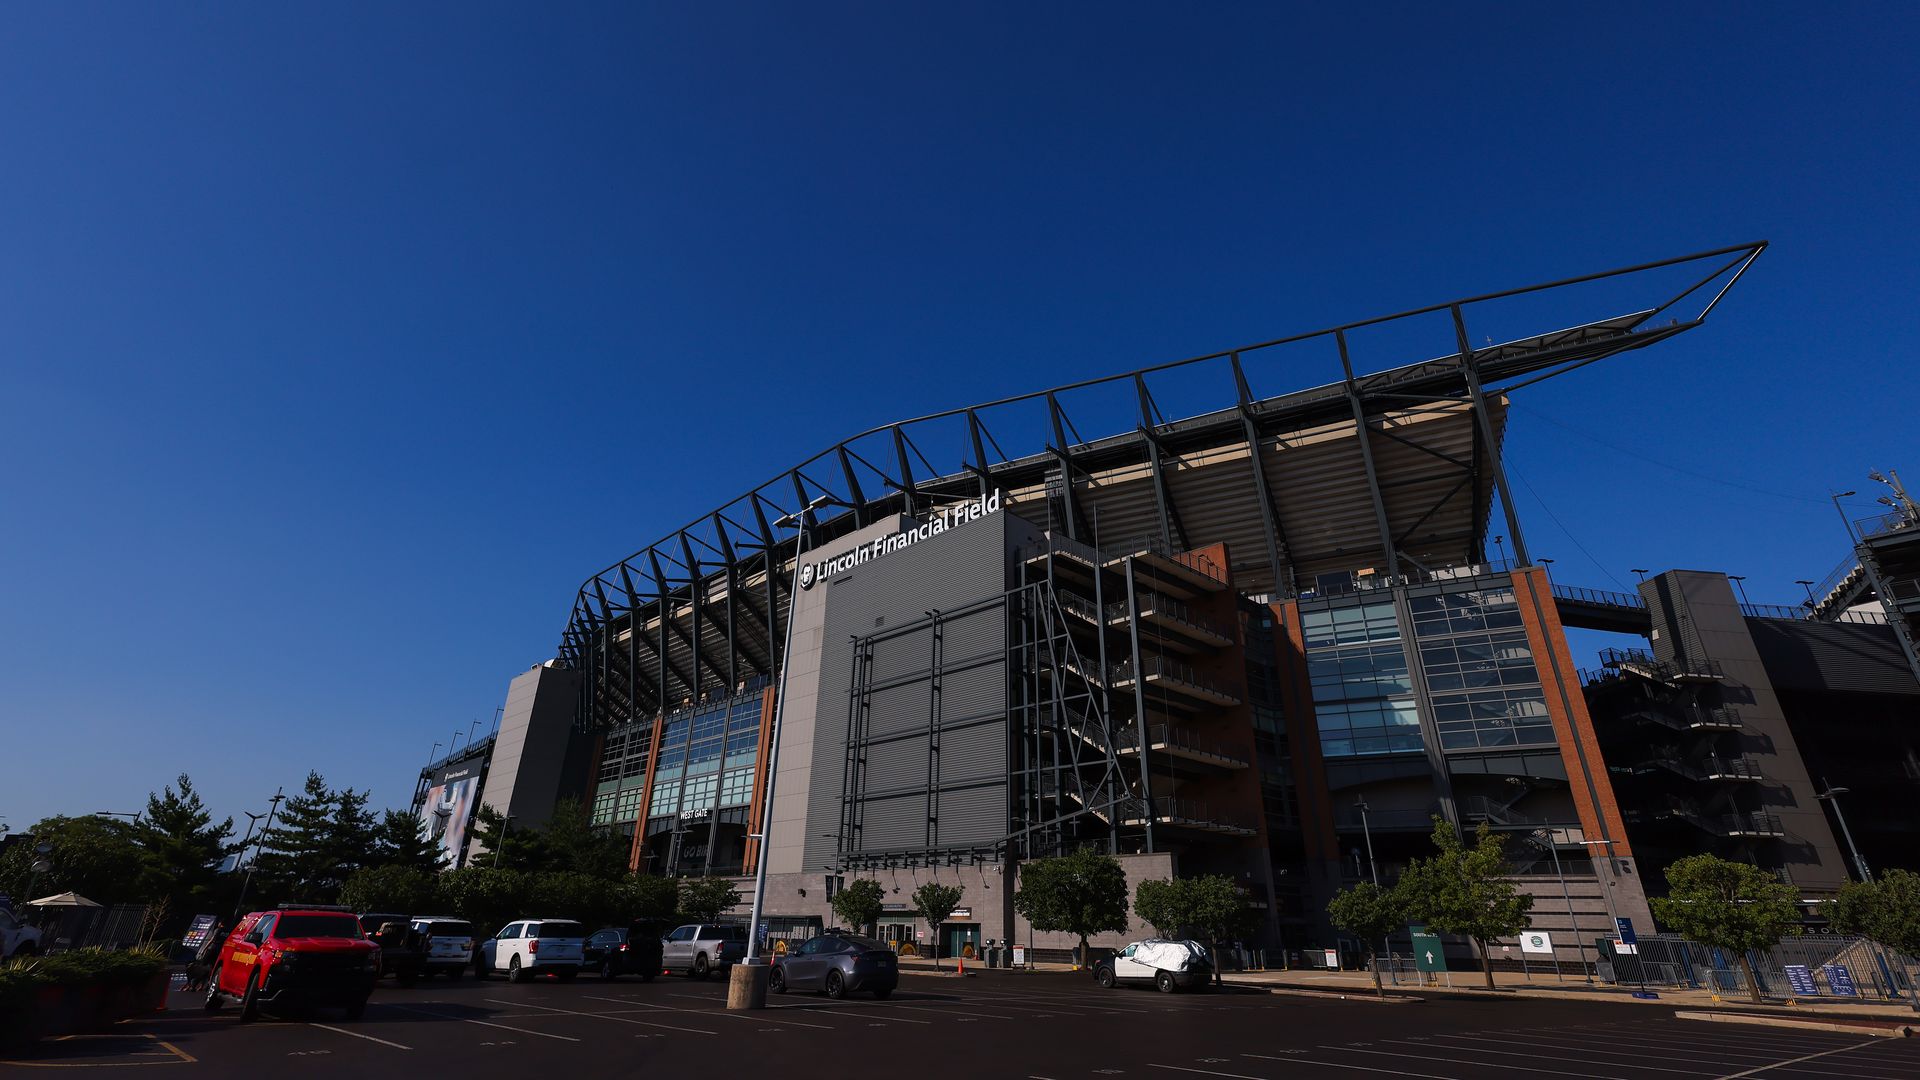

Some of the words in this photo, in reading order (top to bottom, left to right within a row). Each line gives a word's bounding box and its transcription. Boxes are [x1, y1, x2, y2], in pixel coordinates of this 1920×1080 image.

[816, 545, 869, 581] Lincoln
[873, 509, 949, 559] Financial
[954, 488, 999, 527] Field
[680, 810, 694, 820] WEST
[694, 808, 708, 818] GATE
